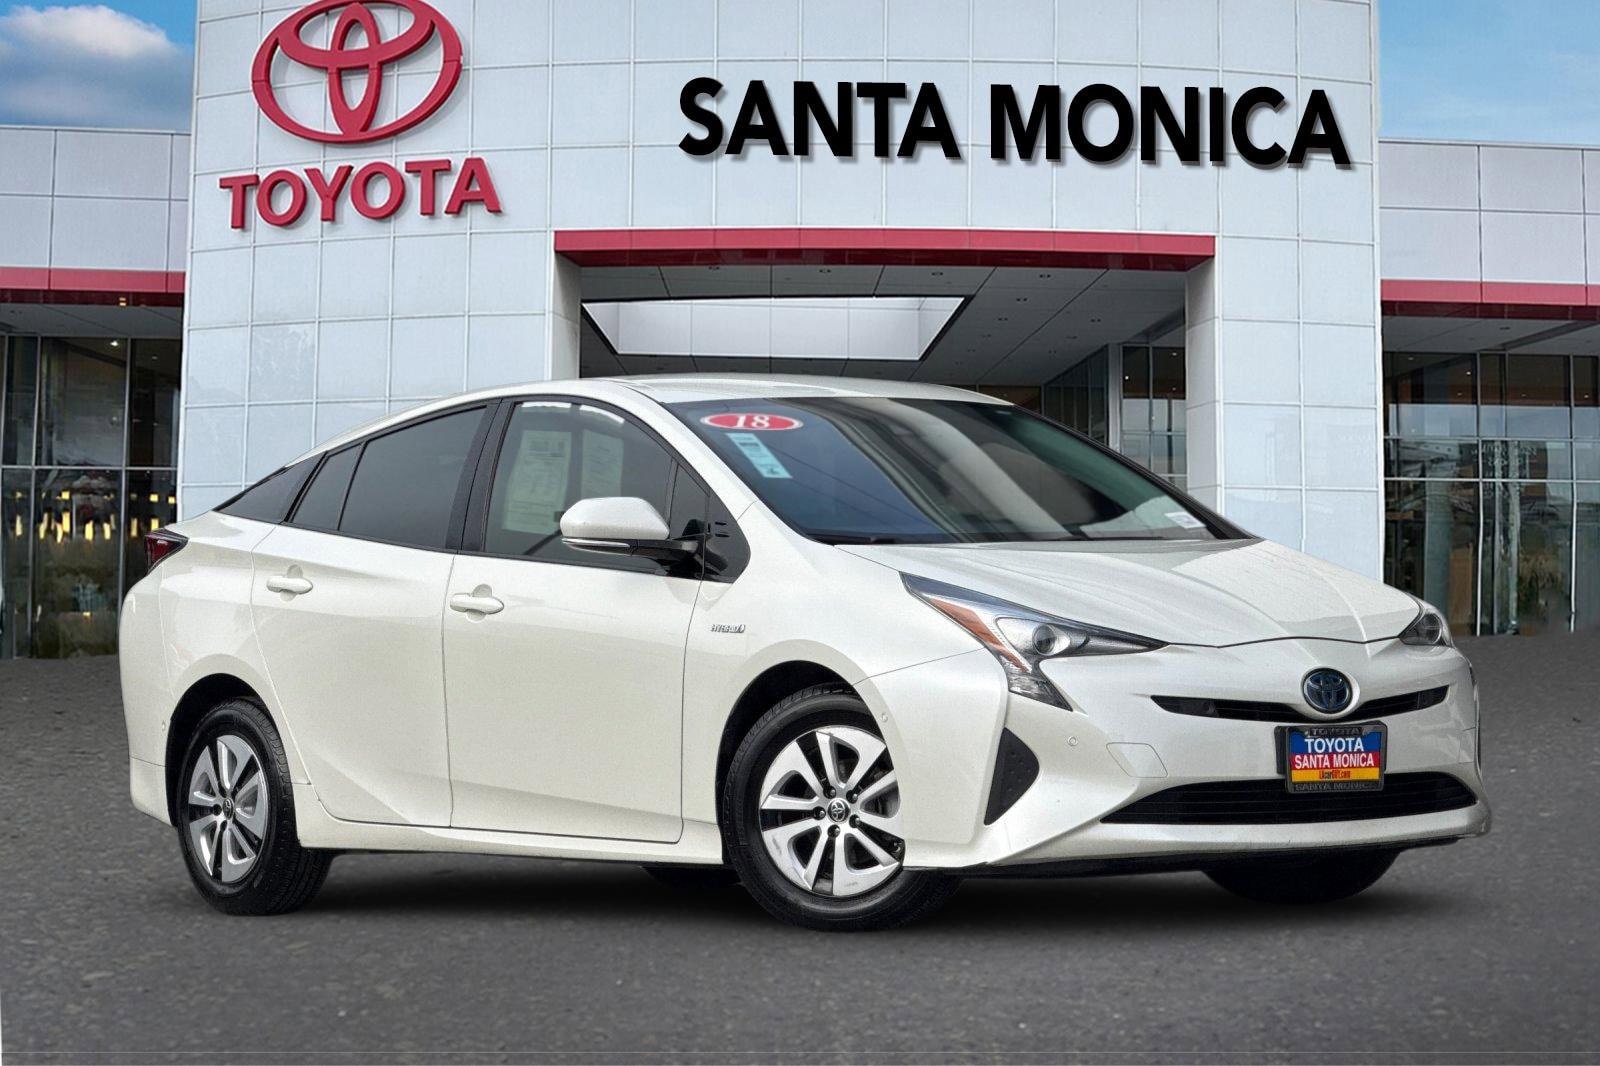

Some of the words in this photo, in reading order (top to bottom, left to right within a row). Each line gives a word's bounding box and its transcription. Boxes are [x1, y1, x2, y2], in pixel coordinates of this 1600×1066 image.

[679, 77, 961, 160] SANTA
[989, 84, 1351, 168] MONICA
[219, 157, 502, 229] TOYOTA
[736, 415, 770, 428] 18
[1304, 738, 1364, 753] TOYOTA
[1294, 754, 1330, 769] SANTA
[1333, 753, 1375, 767] MONICA
